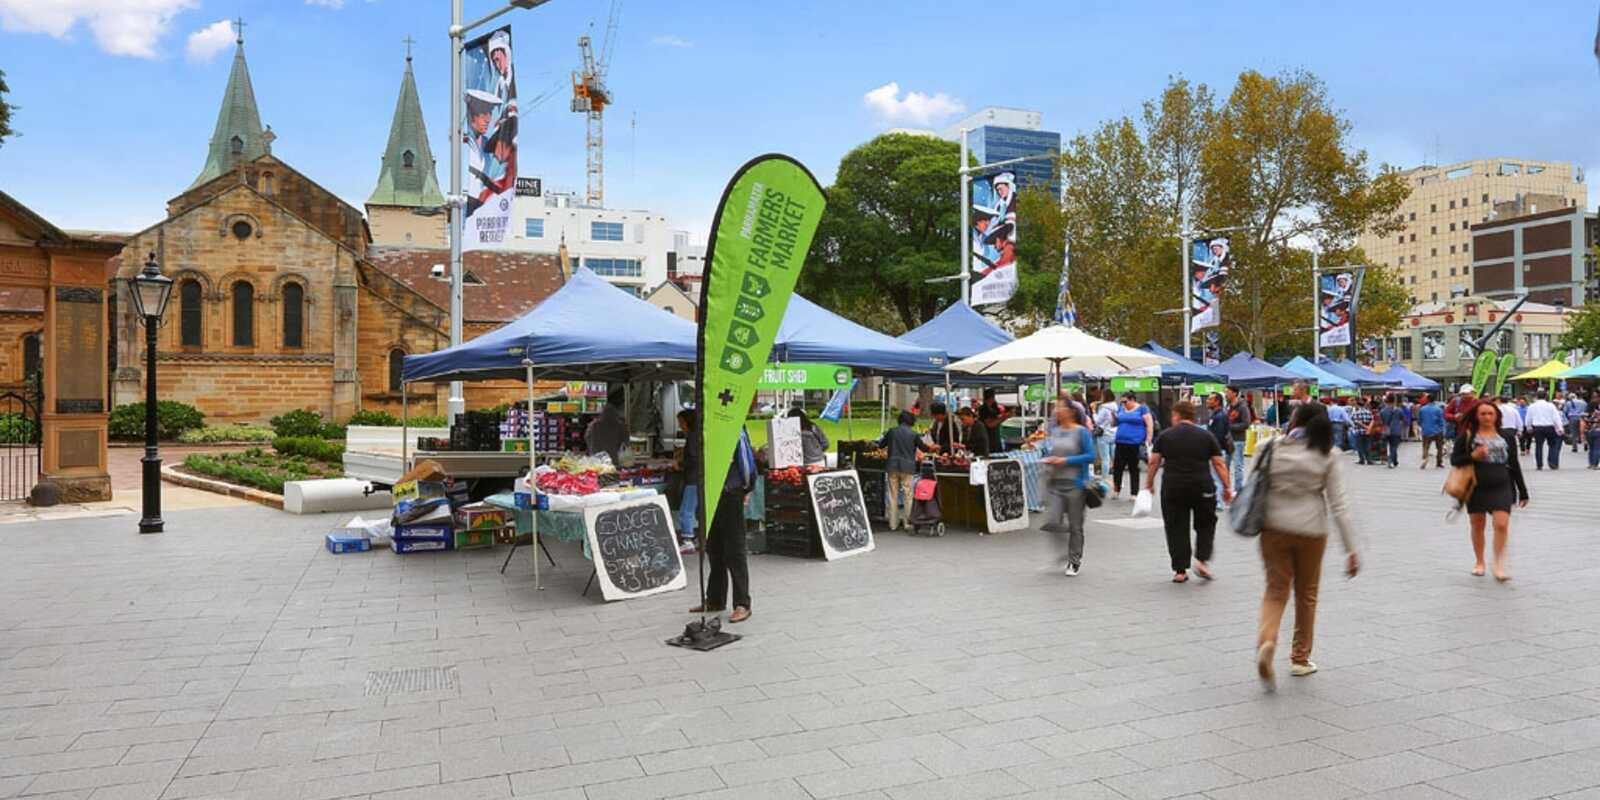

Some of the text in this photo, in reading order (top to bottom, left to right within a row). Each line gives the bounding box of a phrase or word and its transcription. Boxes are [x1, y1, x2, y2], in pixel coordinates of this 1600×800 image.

[747, 187, 785, 270] FARMERS
[769, 196, 806, 271] MARKET
[763, 368, 786, 384] FRUIT
[787, 368, 808, 384] SHED
[599, 508, 661, 535] SWEET
[602, 530, 656, 557] GRAPES
